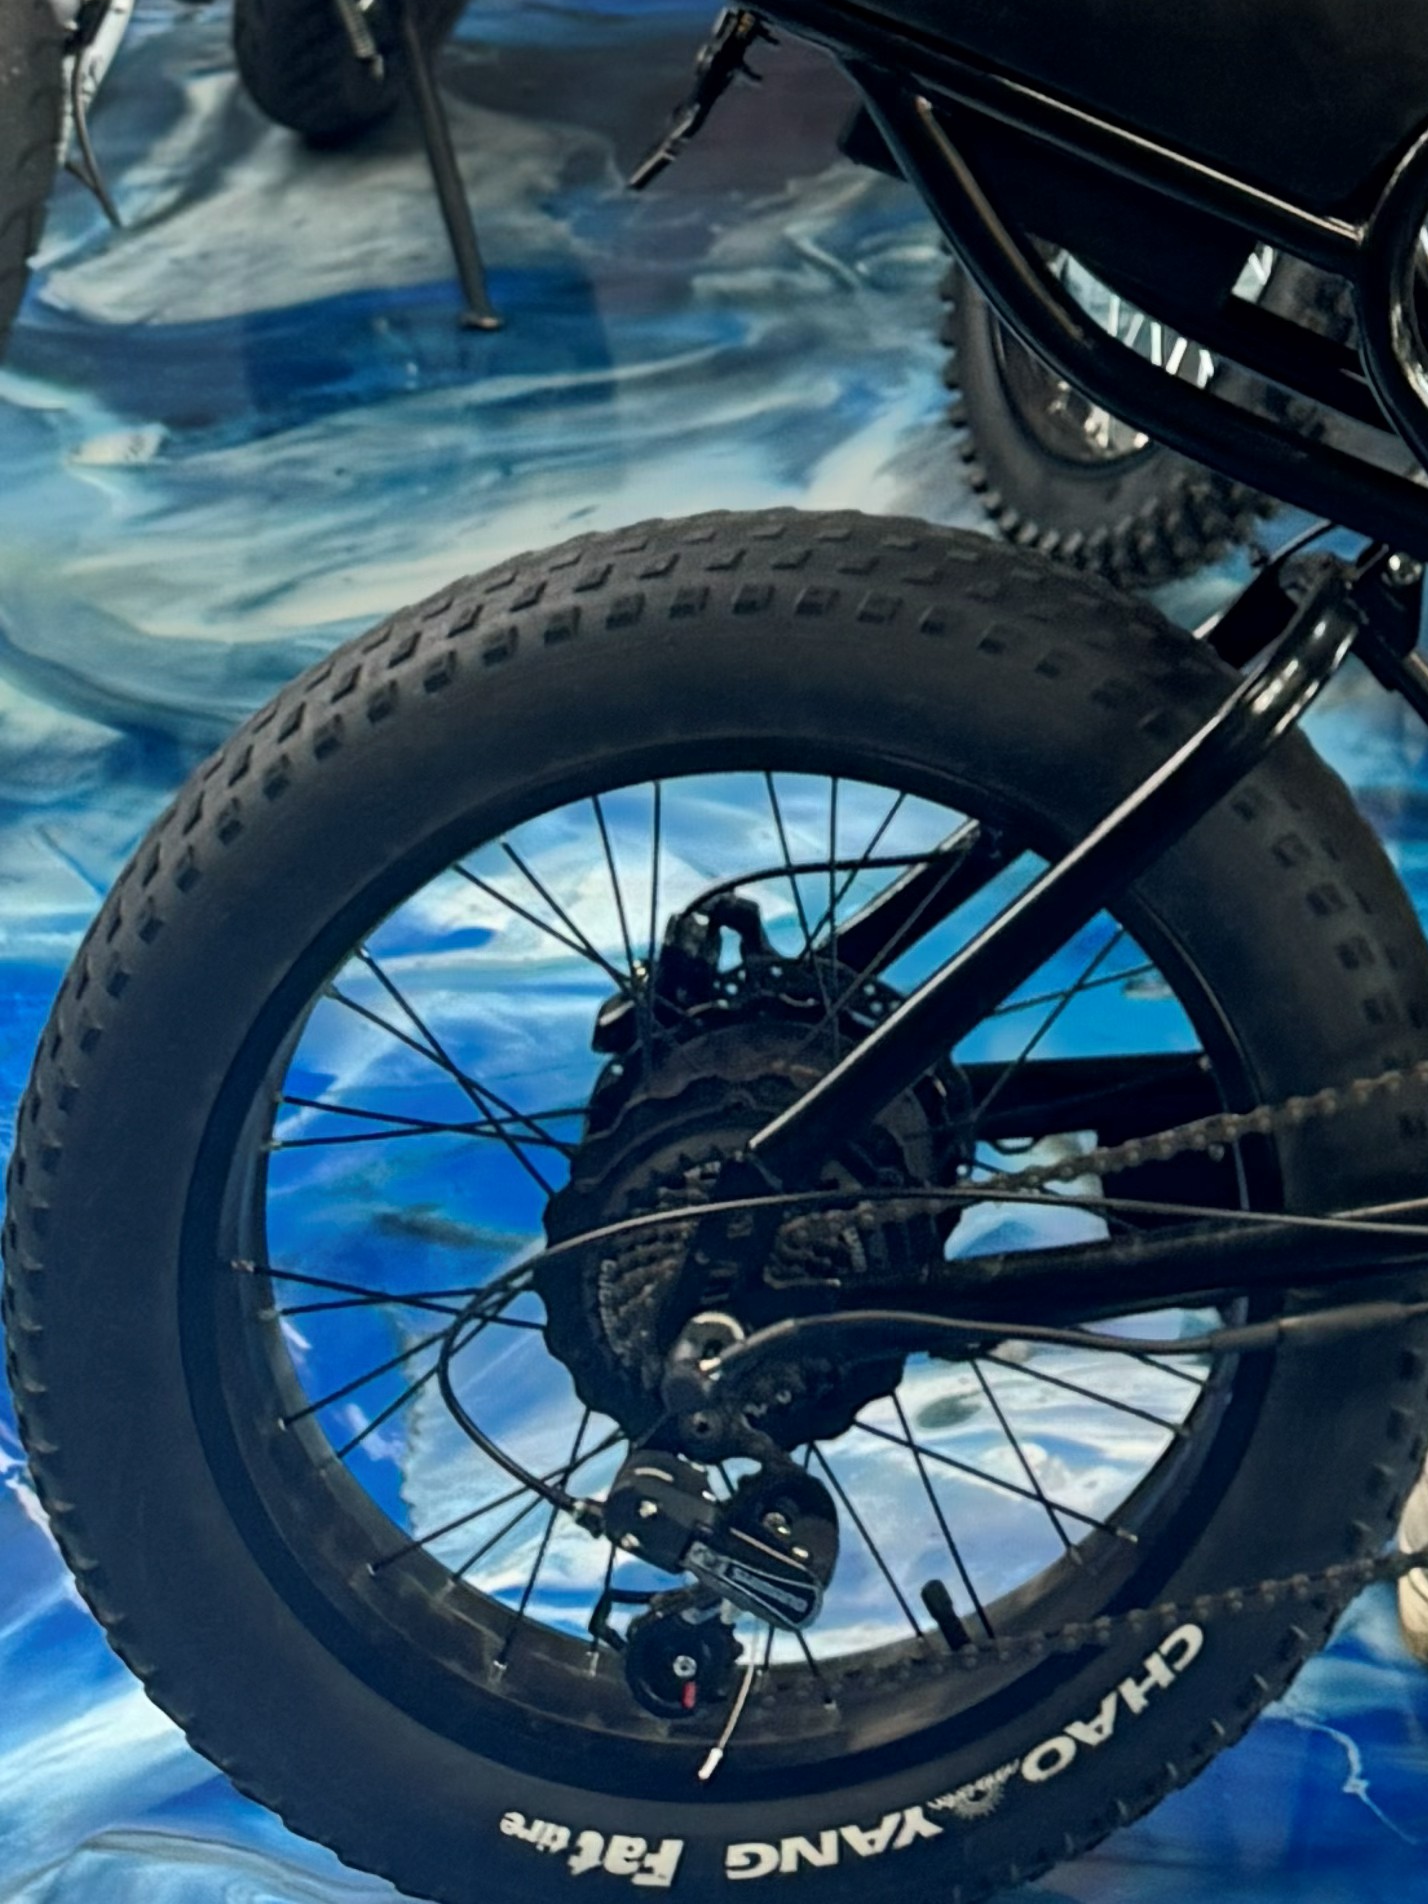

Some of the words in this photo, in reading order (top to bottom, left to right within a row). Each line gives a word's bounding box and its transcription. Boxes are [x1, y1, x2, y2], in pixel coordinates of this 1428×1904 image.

[1020, 1621, 1206, 1786] CHAO
[500, 1809, 566, 1856] tire
[566, 1828, 685, 1888] Fat
[724, 1804, 945, 1882] YANG
